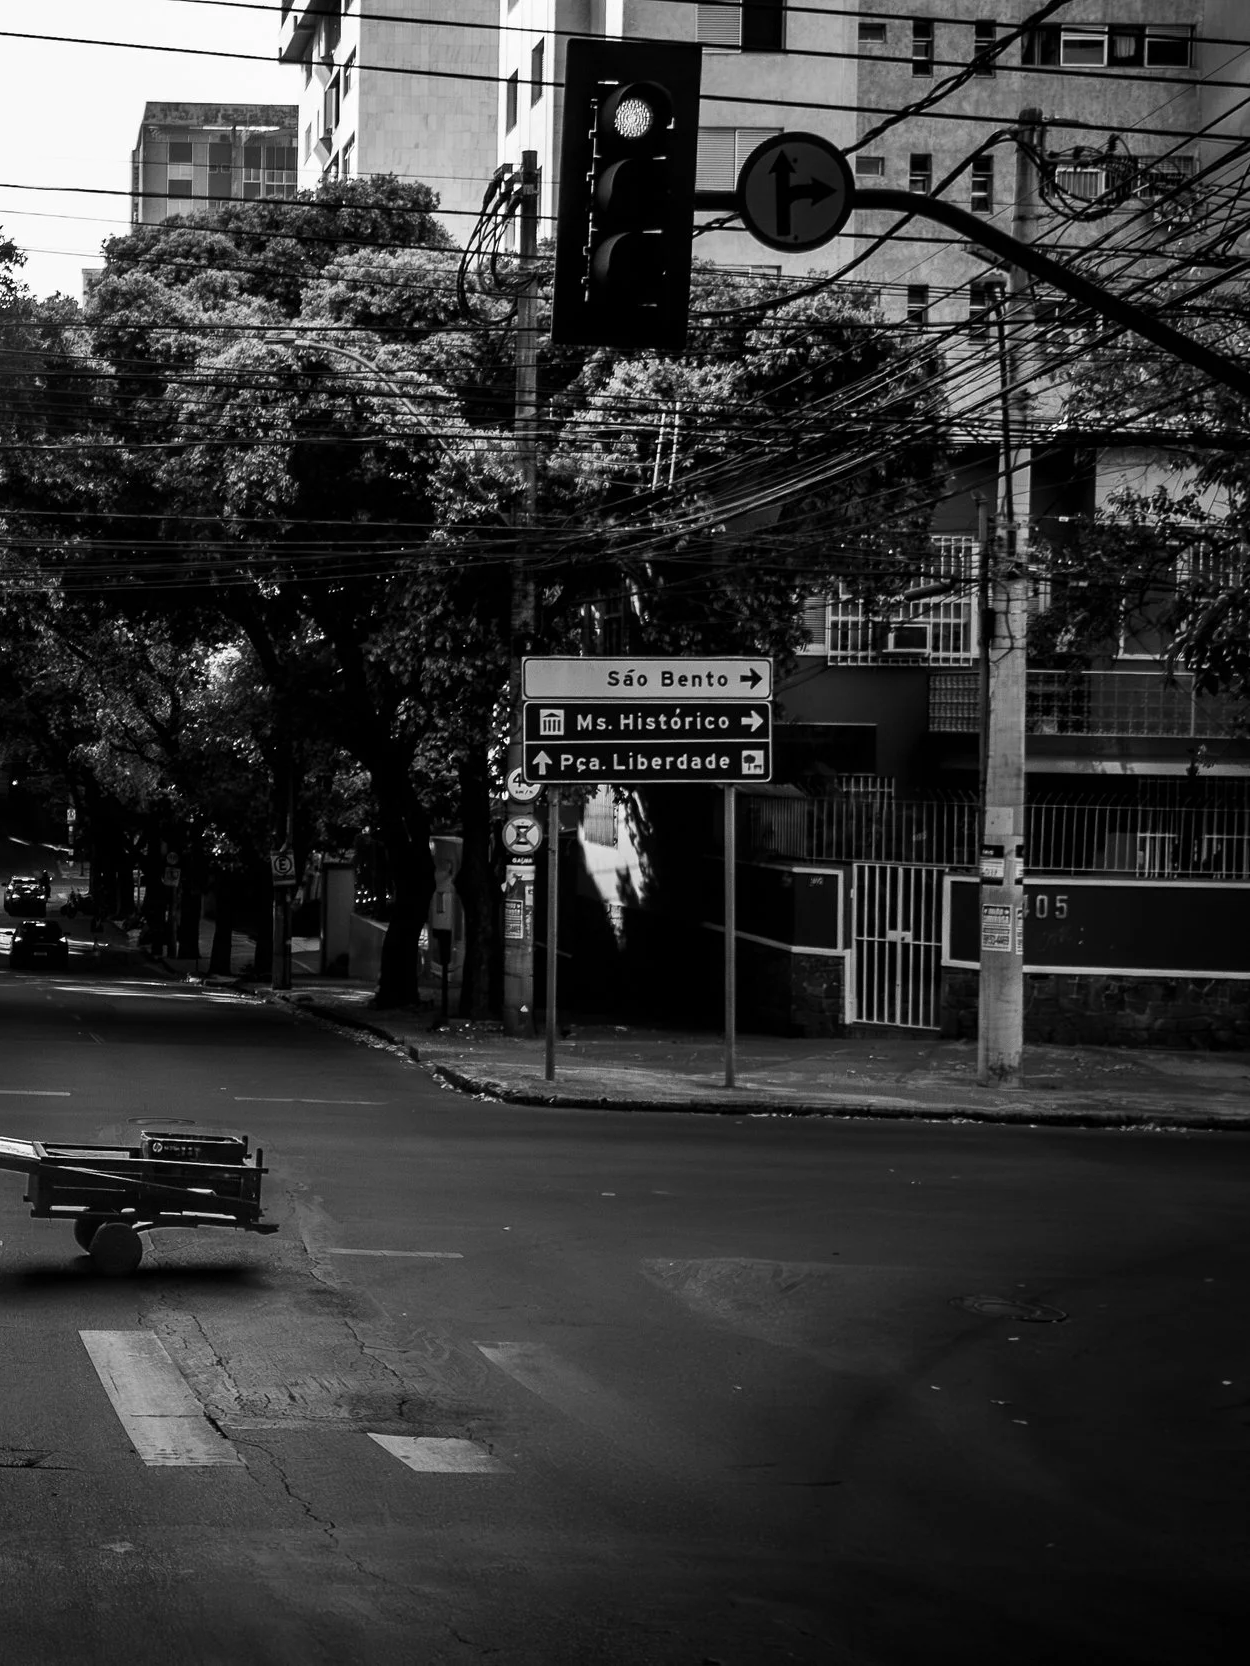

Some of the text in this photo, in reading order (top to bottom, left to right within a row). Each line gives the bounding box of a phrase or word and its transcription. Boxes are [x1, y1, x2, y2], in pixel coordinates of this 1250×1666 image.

[607, 669, 729, 688] São Bento
[576, 708, 730, 731] Ms. Histórico
[560, 752, 730, 773] Pça. Liberdade
